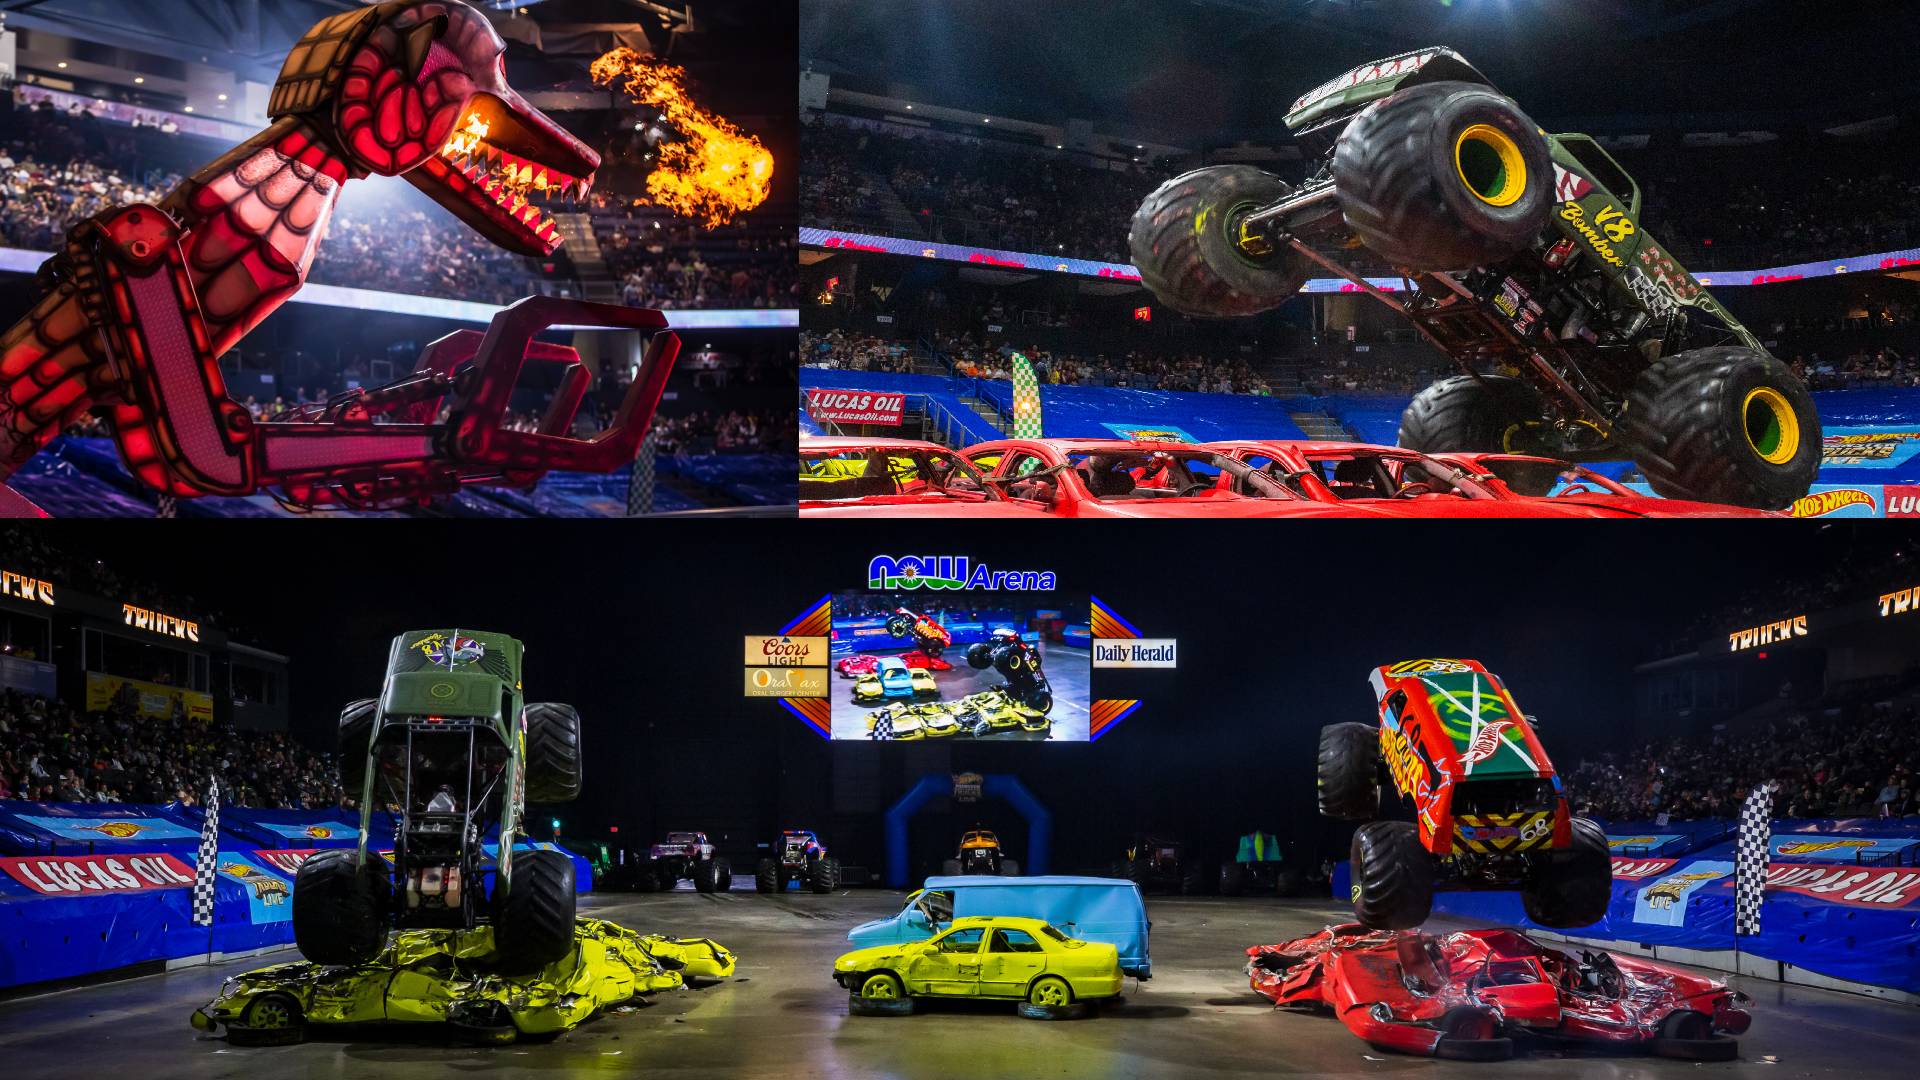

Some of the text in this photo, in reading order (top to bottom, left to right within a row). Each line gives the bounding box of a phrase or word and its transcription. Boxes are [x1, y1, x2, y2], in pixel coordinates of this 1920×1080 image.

[1560, 201, 1625, 267] Bomber
[1595, 204, 1635, 243] V8
[811, 393, 902, 412] LUCAS OIL
[1887, 496, 1920, 514] LU
[0, 570, 55, 606] CKS
[966, 564, 1056, 590] Arena
[123, 603, 199, 642] TRUCKS
[1729, 615, 1808, 651] TRUCKS
[763, 638, 810, 656] Coors
[1096, 645, 1174, 662] Daily Herald
[768, 656, 805, 666] LIGHT
[1520, 819, 1550, 841] 68
[17, 858, 141, 892] LUCAS
[129, 857, 195, 885] OIL
[263, 893, 284, 907] LIVE
[1649, 895, 1672, 910] LIVE
